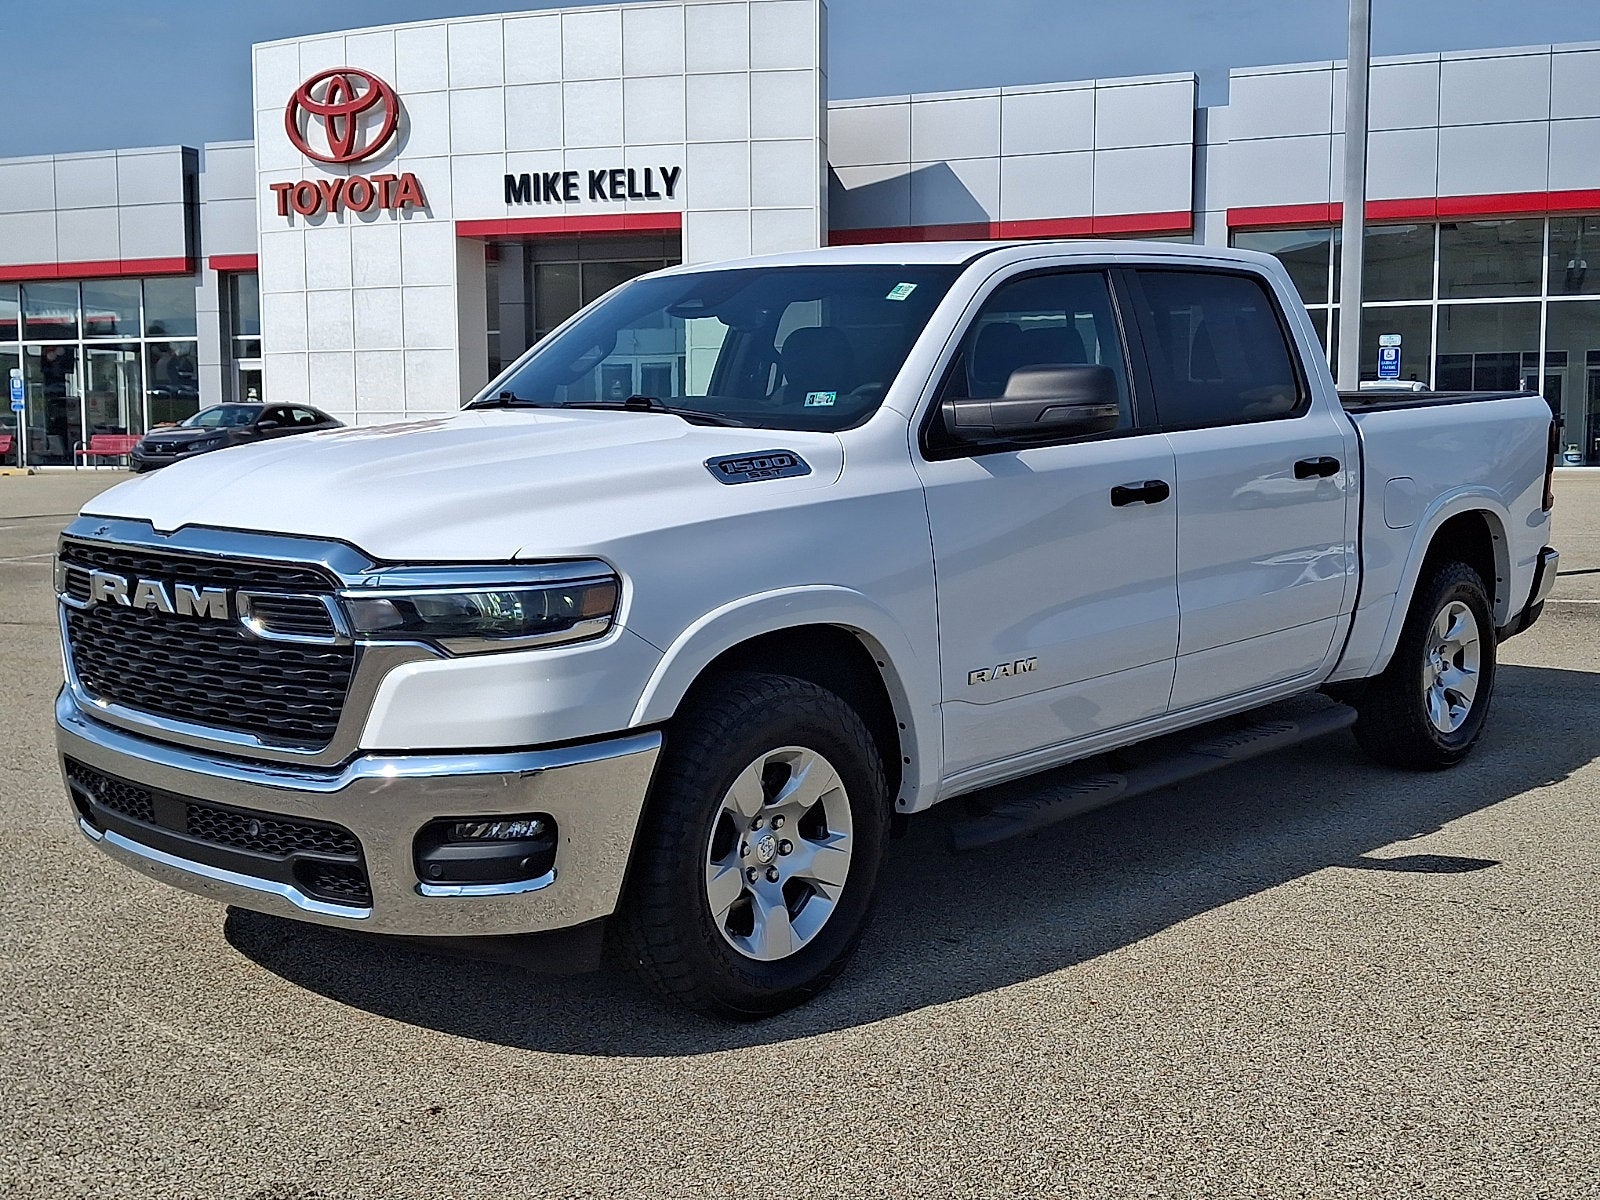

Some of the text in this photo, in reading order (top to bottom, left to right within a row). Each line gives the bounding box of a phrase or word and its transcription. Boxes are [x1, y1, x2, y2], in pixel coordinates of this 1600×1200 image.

[270, 173, 425, 216] TOYOTA
[504, 166, 680, 203] MIKE KELLY
[722, 456, 792, 473] 1500
[91, 570, 229, 620] RAM
[967, 656, 1038, 686] RAM
